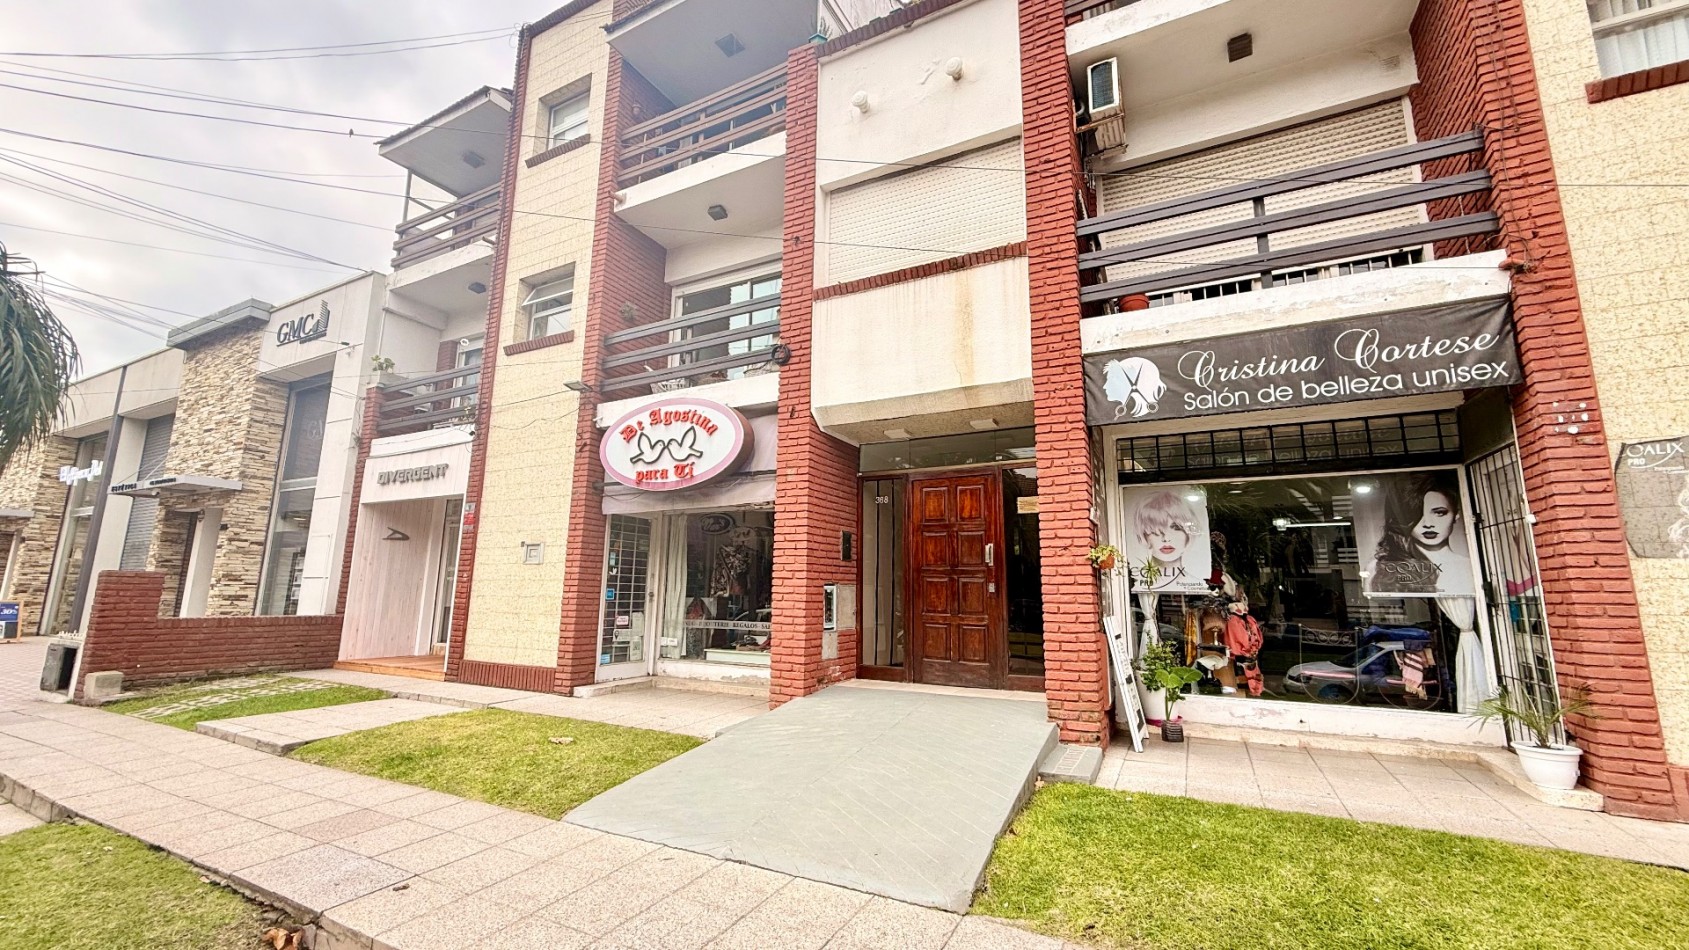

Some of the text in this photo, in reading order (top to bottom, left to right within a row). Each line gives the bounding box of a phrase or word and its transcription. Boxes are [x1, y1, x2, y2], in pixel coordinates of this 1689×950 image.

[277, 313, 315, 343] GMC
[1178, 328, 1500, 392] Cristina Cortese
[1184, 360, 1510, 410] Salón de belleza unisex
[649, 408, 719, 436] Agostina
[1622, 441, 1686, 458] OALIX
[377, 463, 449, 486] DIVERGENT
[1627, 458, 1646, 467] PRO
[635, 467, 669, 485] para
